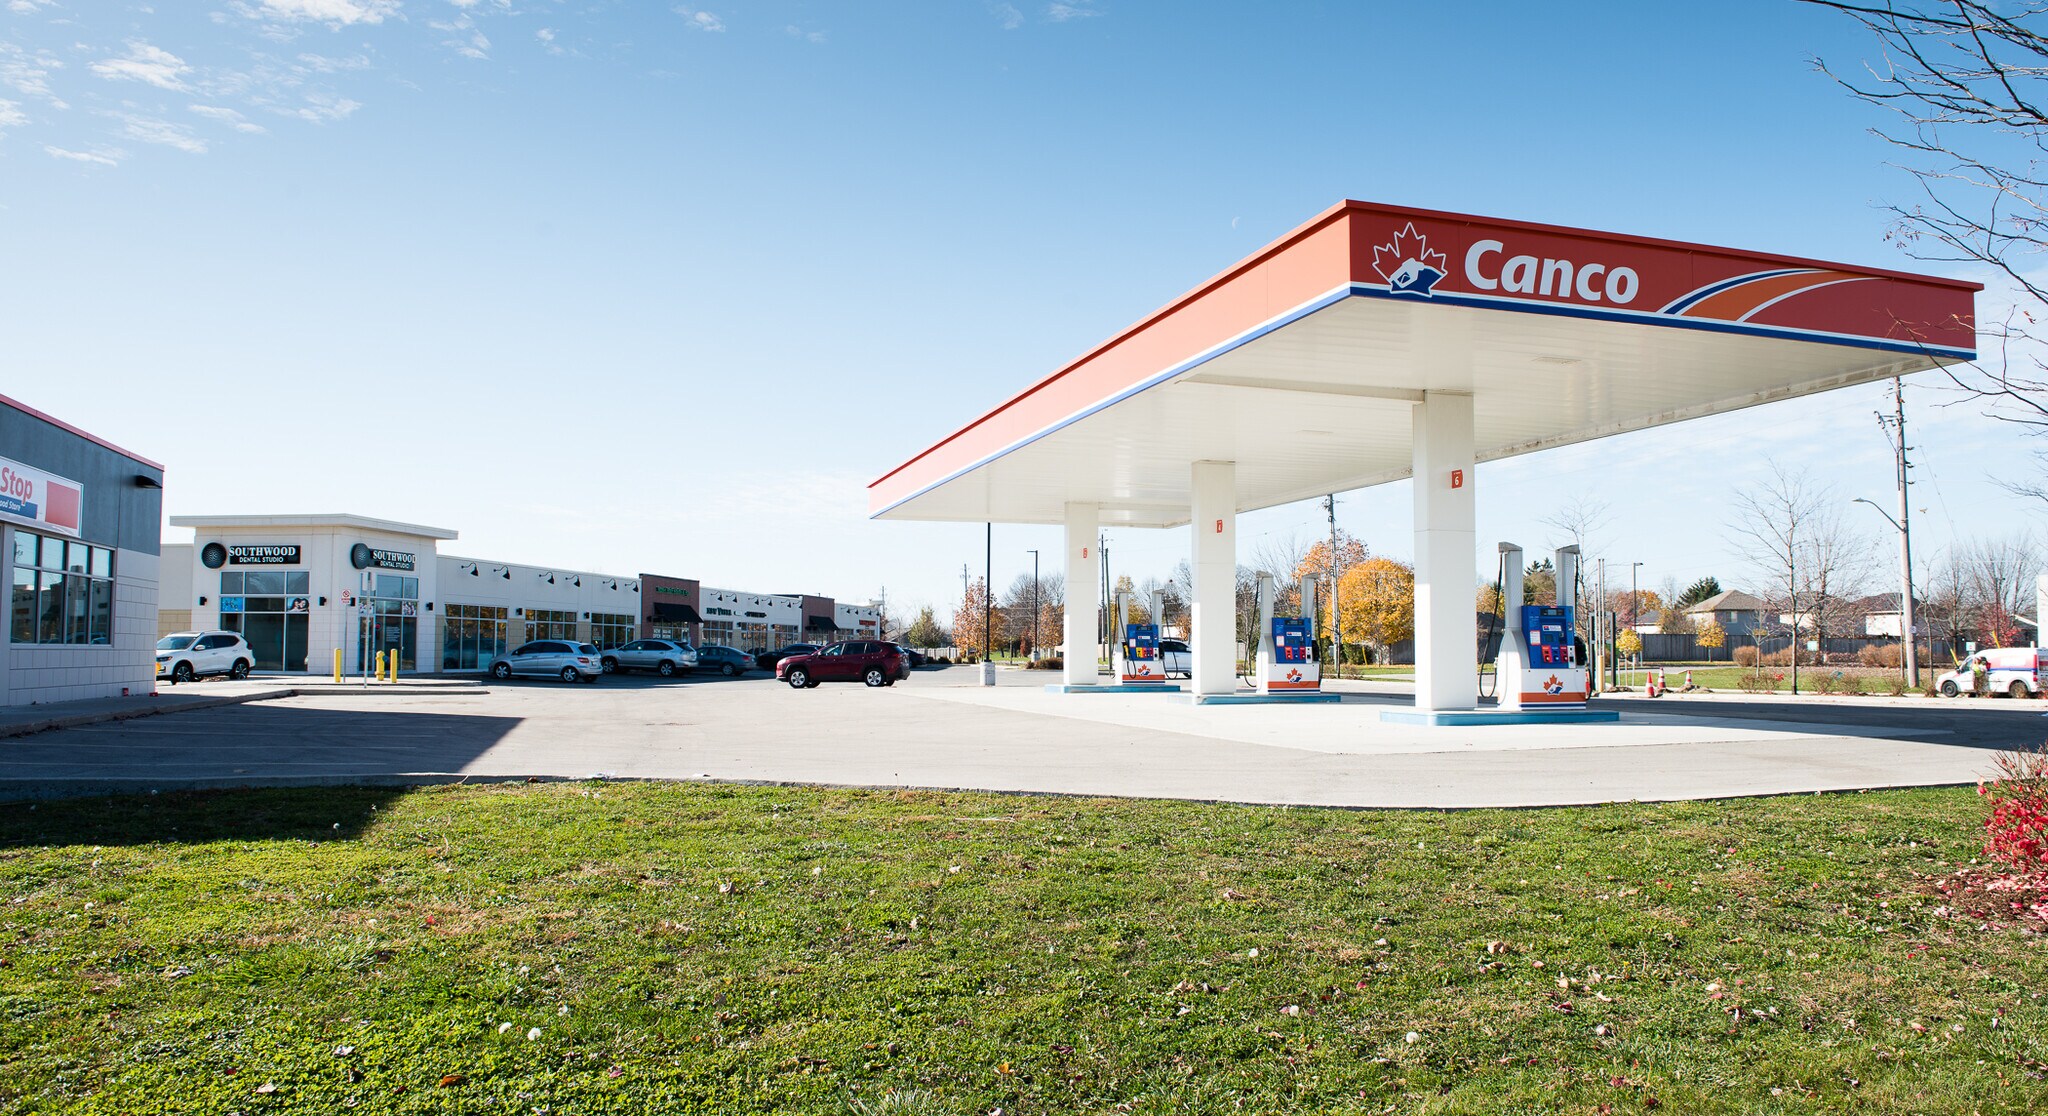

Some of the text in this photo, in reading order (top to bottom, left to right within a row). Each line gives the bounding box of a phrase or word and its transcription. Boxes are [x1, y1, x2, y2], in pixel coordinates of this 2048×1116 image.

[1465, 239, 1640, 304] Canco
[0, 466, 33, 505] Stop
[9, 500, 21, 511] Store
[229, 546, 296, 556] SOUTHWOOD
[372, 550, 417, 564] SOUTHWOOD
